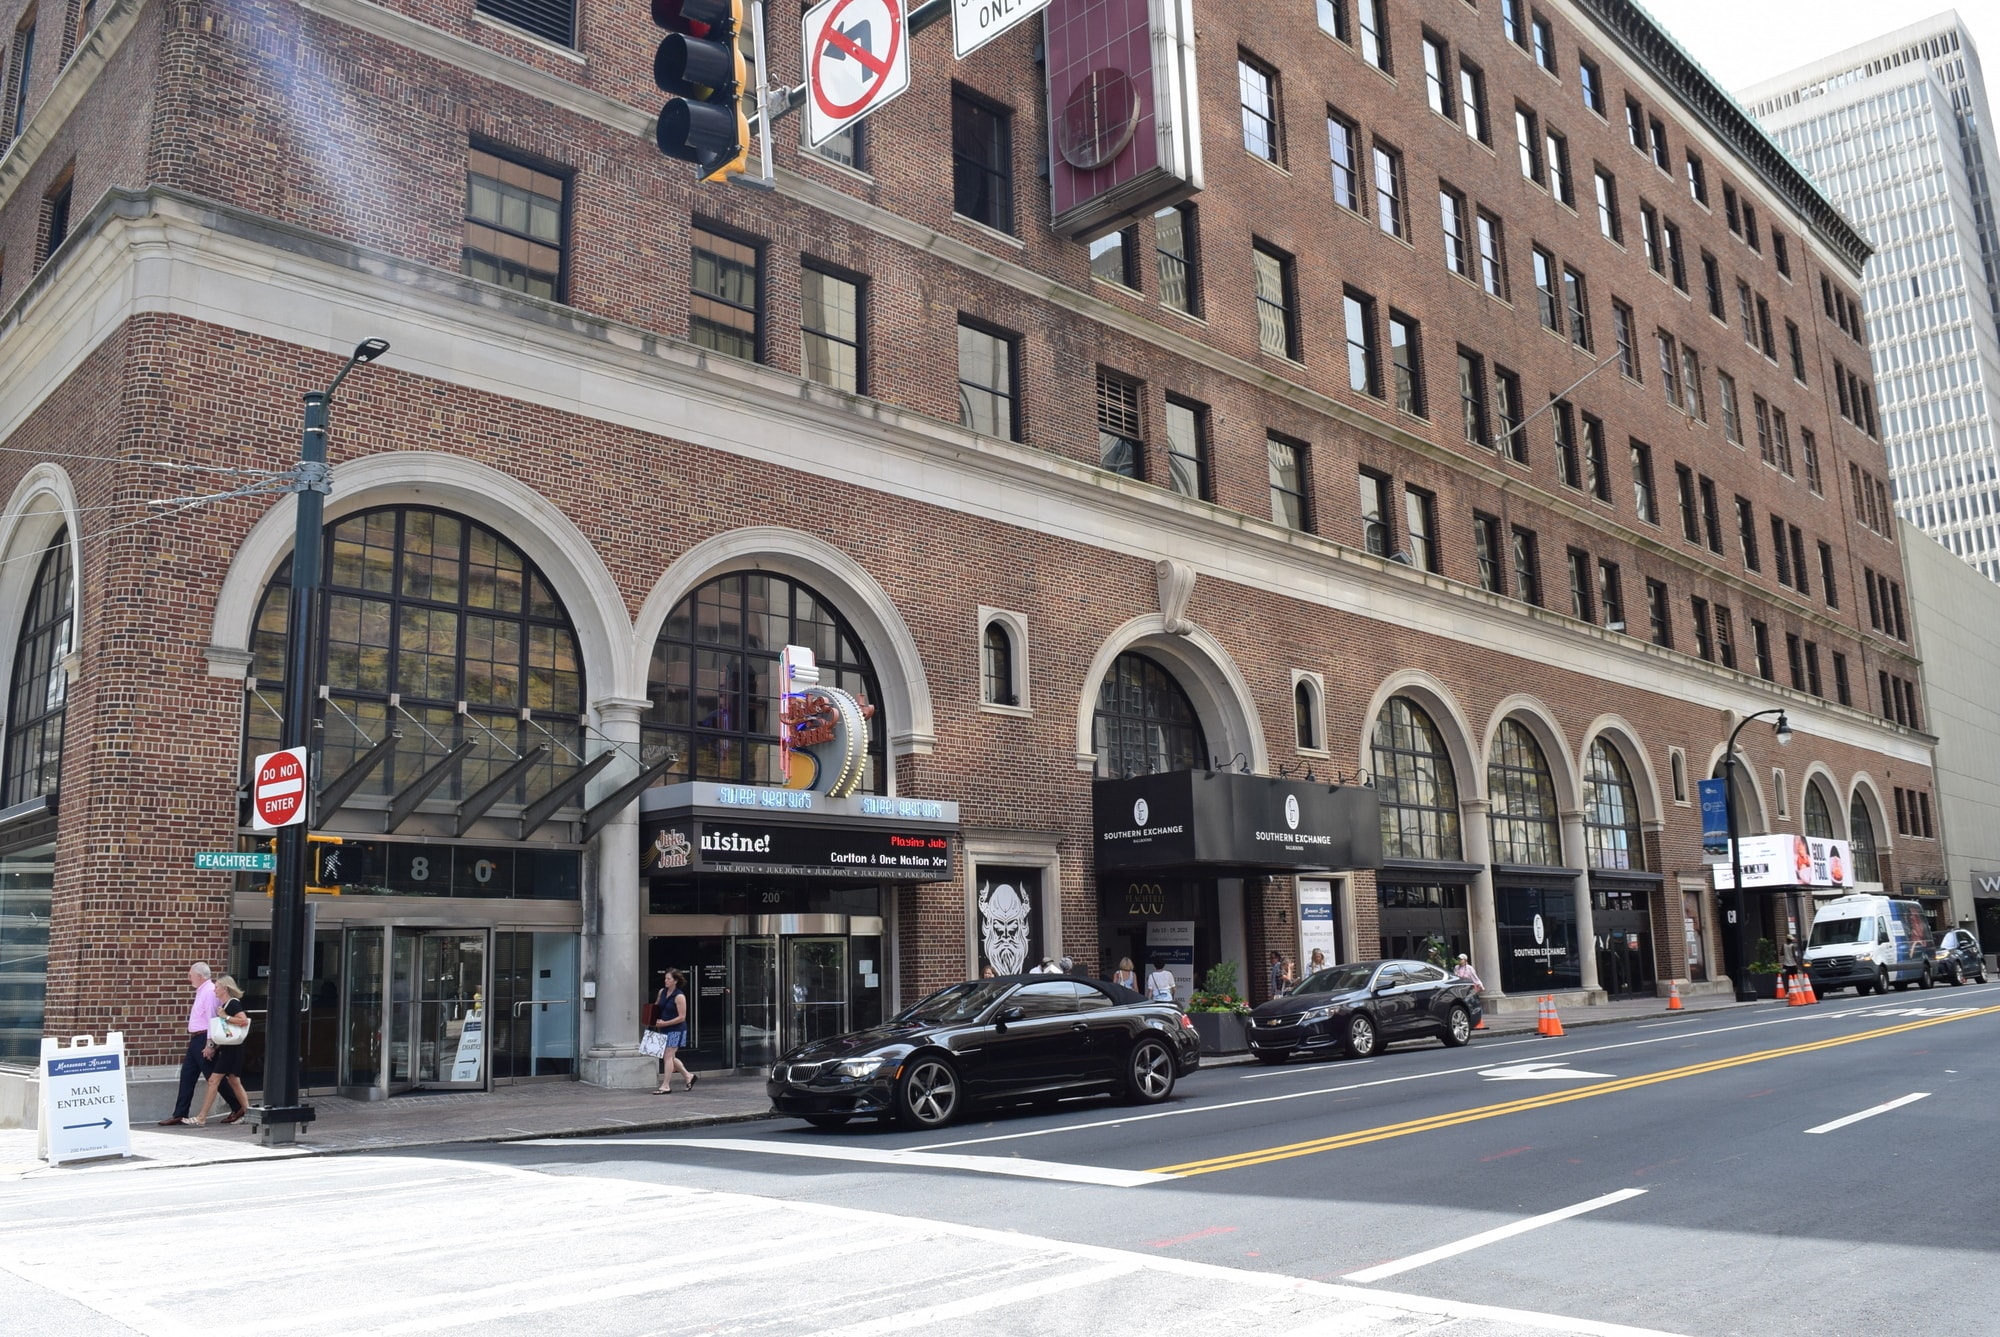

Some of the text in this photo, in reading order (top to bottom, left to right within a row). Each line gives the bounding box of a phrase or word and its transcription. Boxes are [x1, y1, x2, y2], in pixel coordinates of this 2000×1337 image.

[980, 0, 1022, 28] ONL
[263, 763, 298, 781] DO NOT
[265, 797, 294, 813] ENTER
[655, 828, 689, 850] Juke
[1103, 825, 1183, 840] SOUTHERN EXCHANGE
[1255, 831, 1331, 845] SOUTHERN EXCHANGE
[701, 831, 770, 853] uisine!
[890, 836, 947, 849] Playing July
[198, 854, 259, 868] PEACHTREE
[657, 850, 688, 869] Joint
[830, 852, 867, 864] Carlton
[870, 854, 877, 864] &
[879, 854, 897, 865] One
[900, 855, 930, 866] Nation
[766, 866, 783, 874] JUKE
[784, 867, 804, 875] JOINT
[877, 870, 895, 878] JOINT
[762, 892, 780, 903] 200
[1128, 883, 1164, 915] 200
[1513, 947, 1566, 957] SOUTHERN EXCHANGE
[71, 1085, 101, 1097] MAIN
[57, 1095, 116, 1109] ENTRANCE
